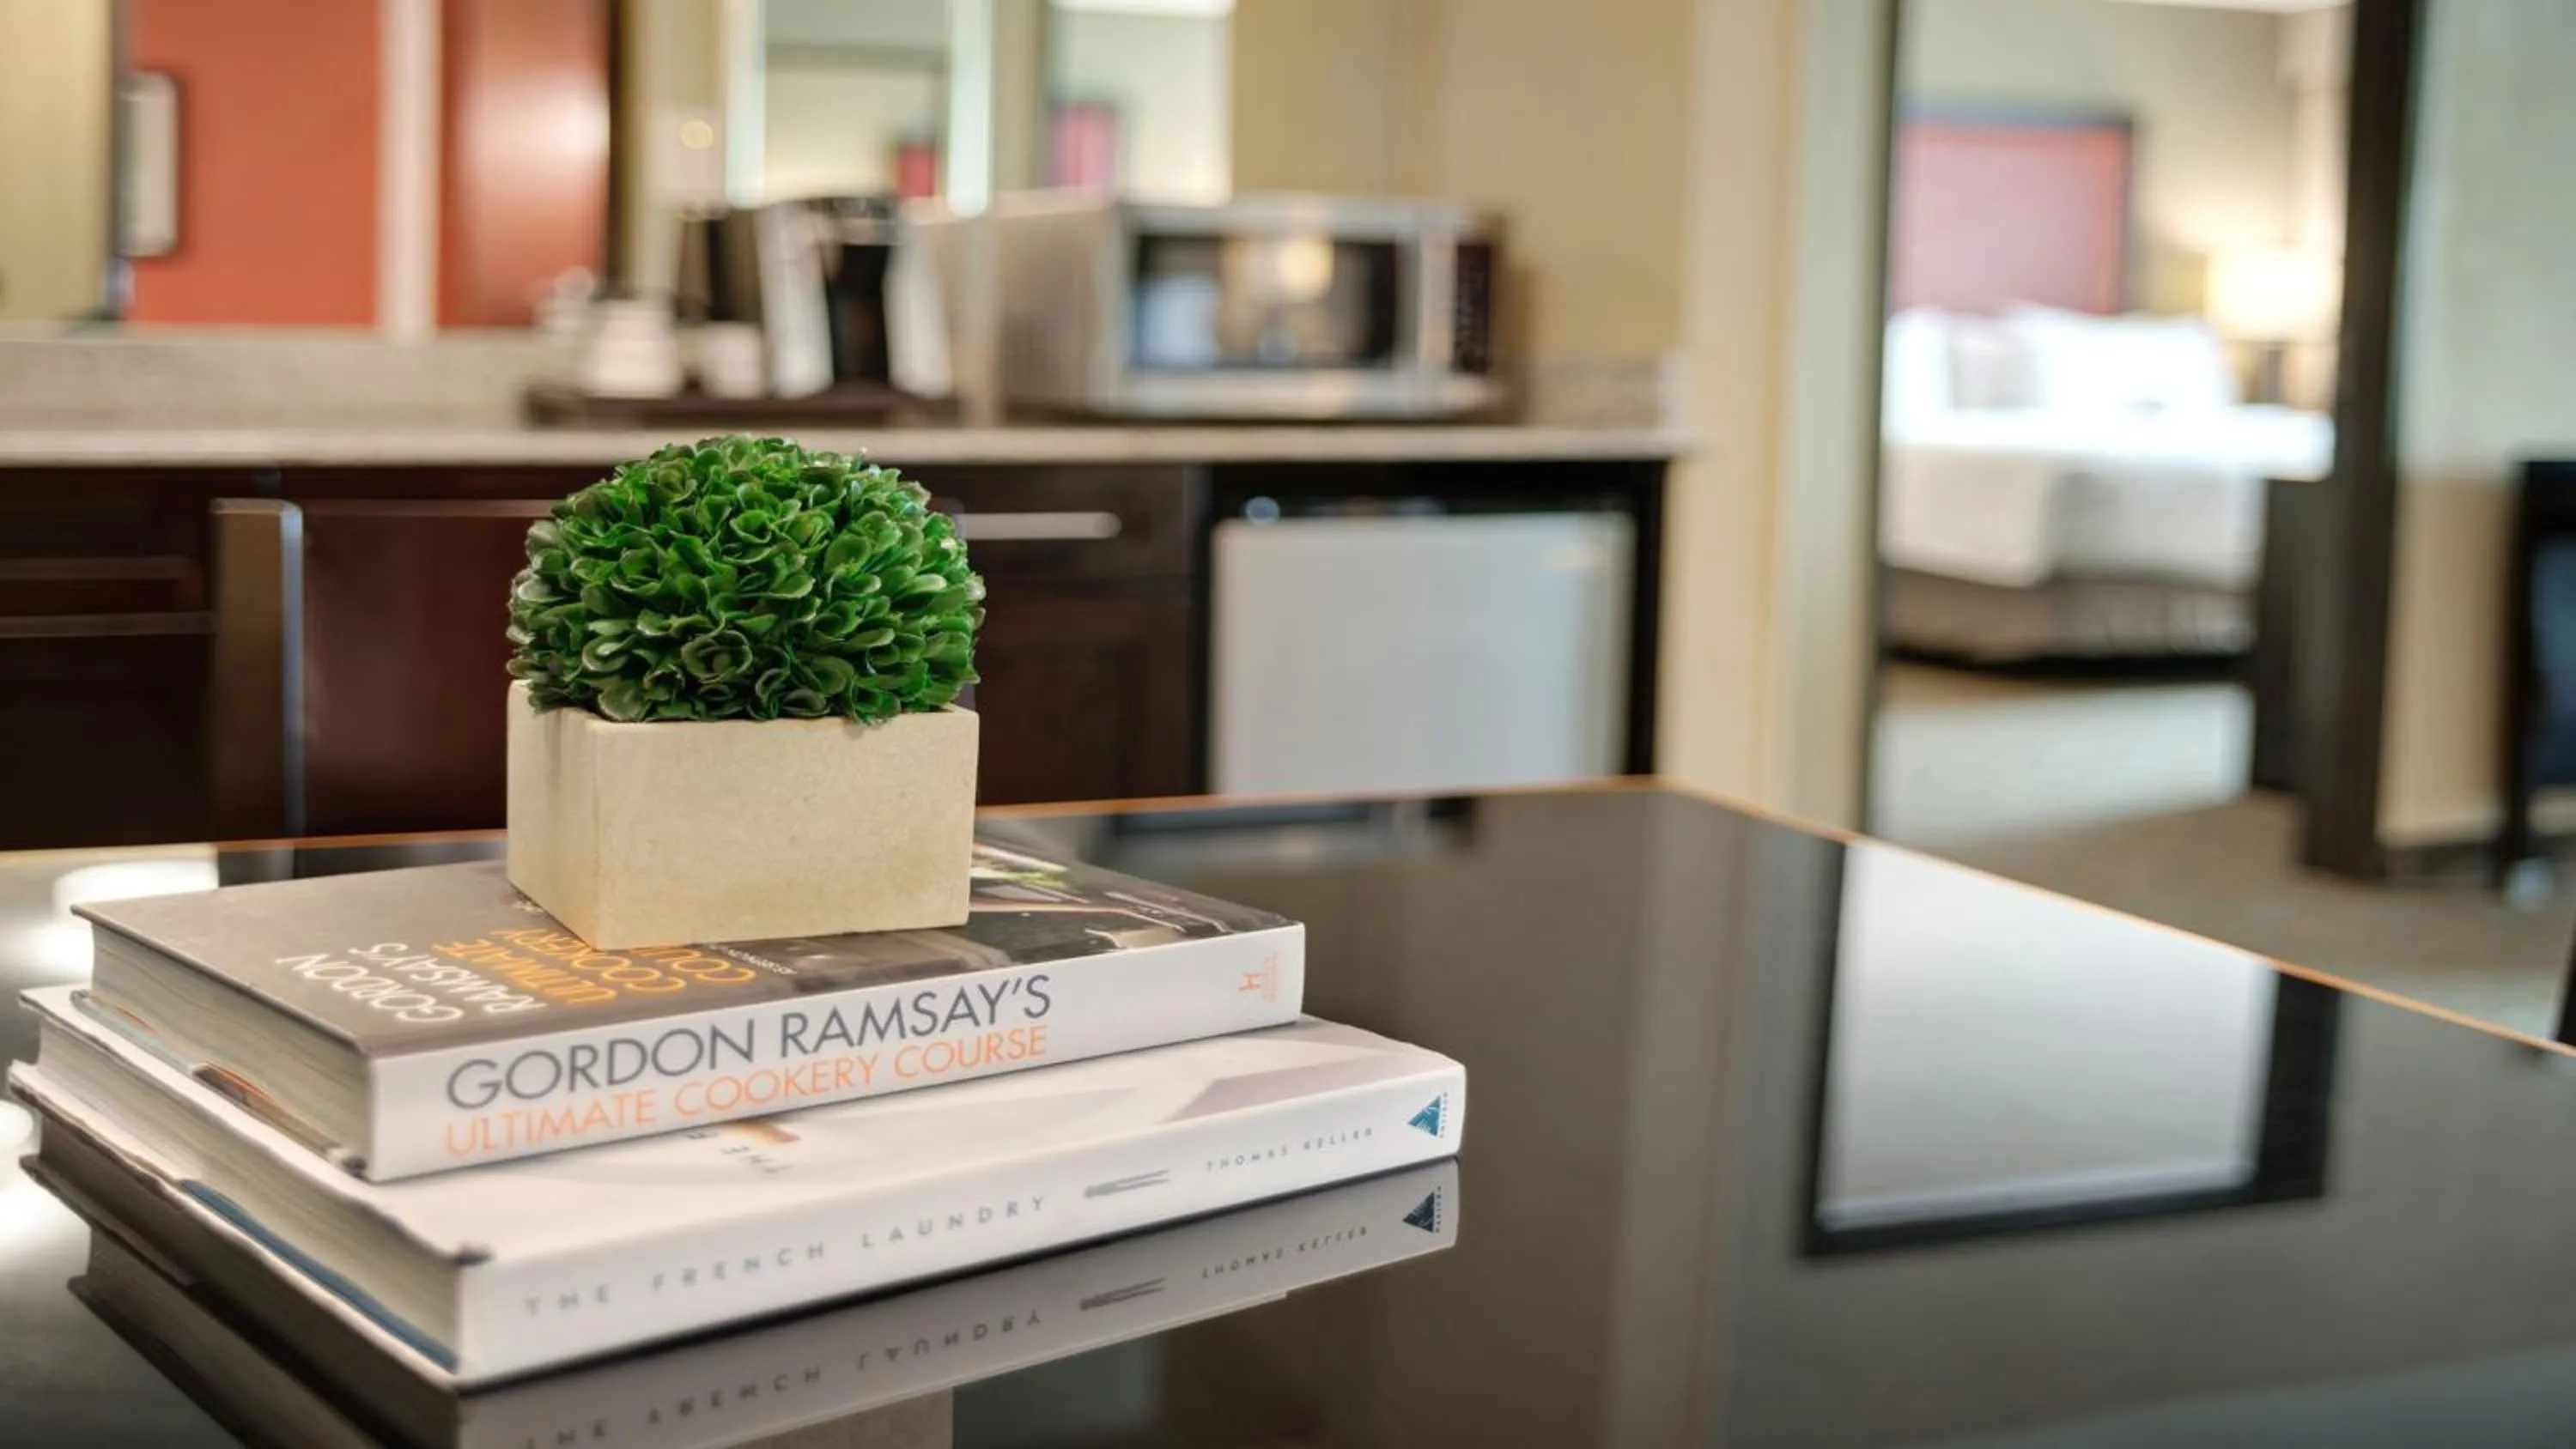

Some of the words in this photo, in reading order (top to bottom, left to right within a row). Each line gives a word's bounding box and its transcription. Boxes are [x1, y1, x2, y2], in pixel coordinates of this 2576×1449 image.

[275, 952, 465, 1023] GORDON
[349, 942, 548, 1015] RAMSAY'S
[432, 938, 617, 1005] ULTIMATE
[447, 1018, 755, 1110] GORDON
[781, 974, 1051, 1058] RAMSAY'S
[443, 1088, 657, 1157] ULTIMATE
[674, 1054, 881, 1118] COOKERY
[894, 1026, 1048, 1080] COURSE
[1206, 1146, 1288, 1173] THOMAS
[1303, 1126, 1374, 1151] KELLER
[523, 1285, 610, 1317] THE
[653, 1241, 824, 1291] FRENCH
[863, 1194, 1046, 1249] LAUNDRY
